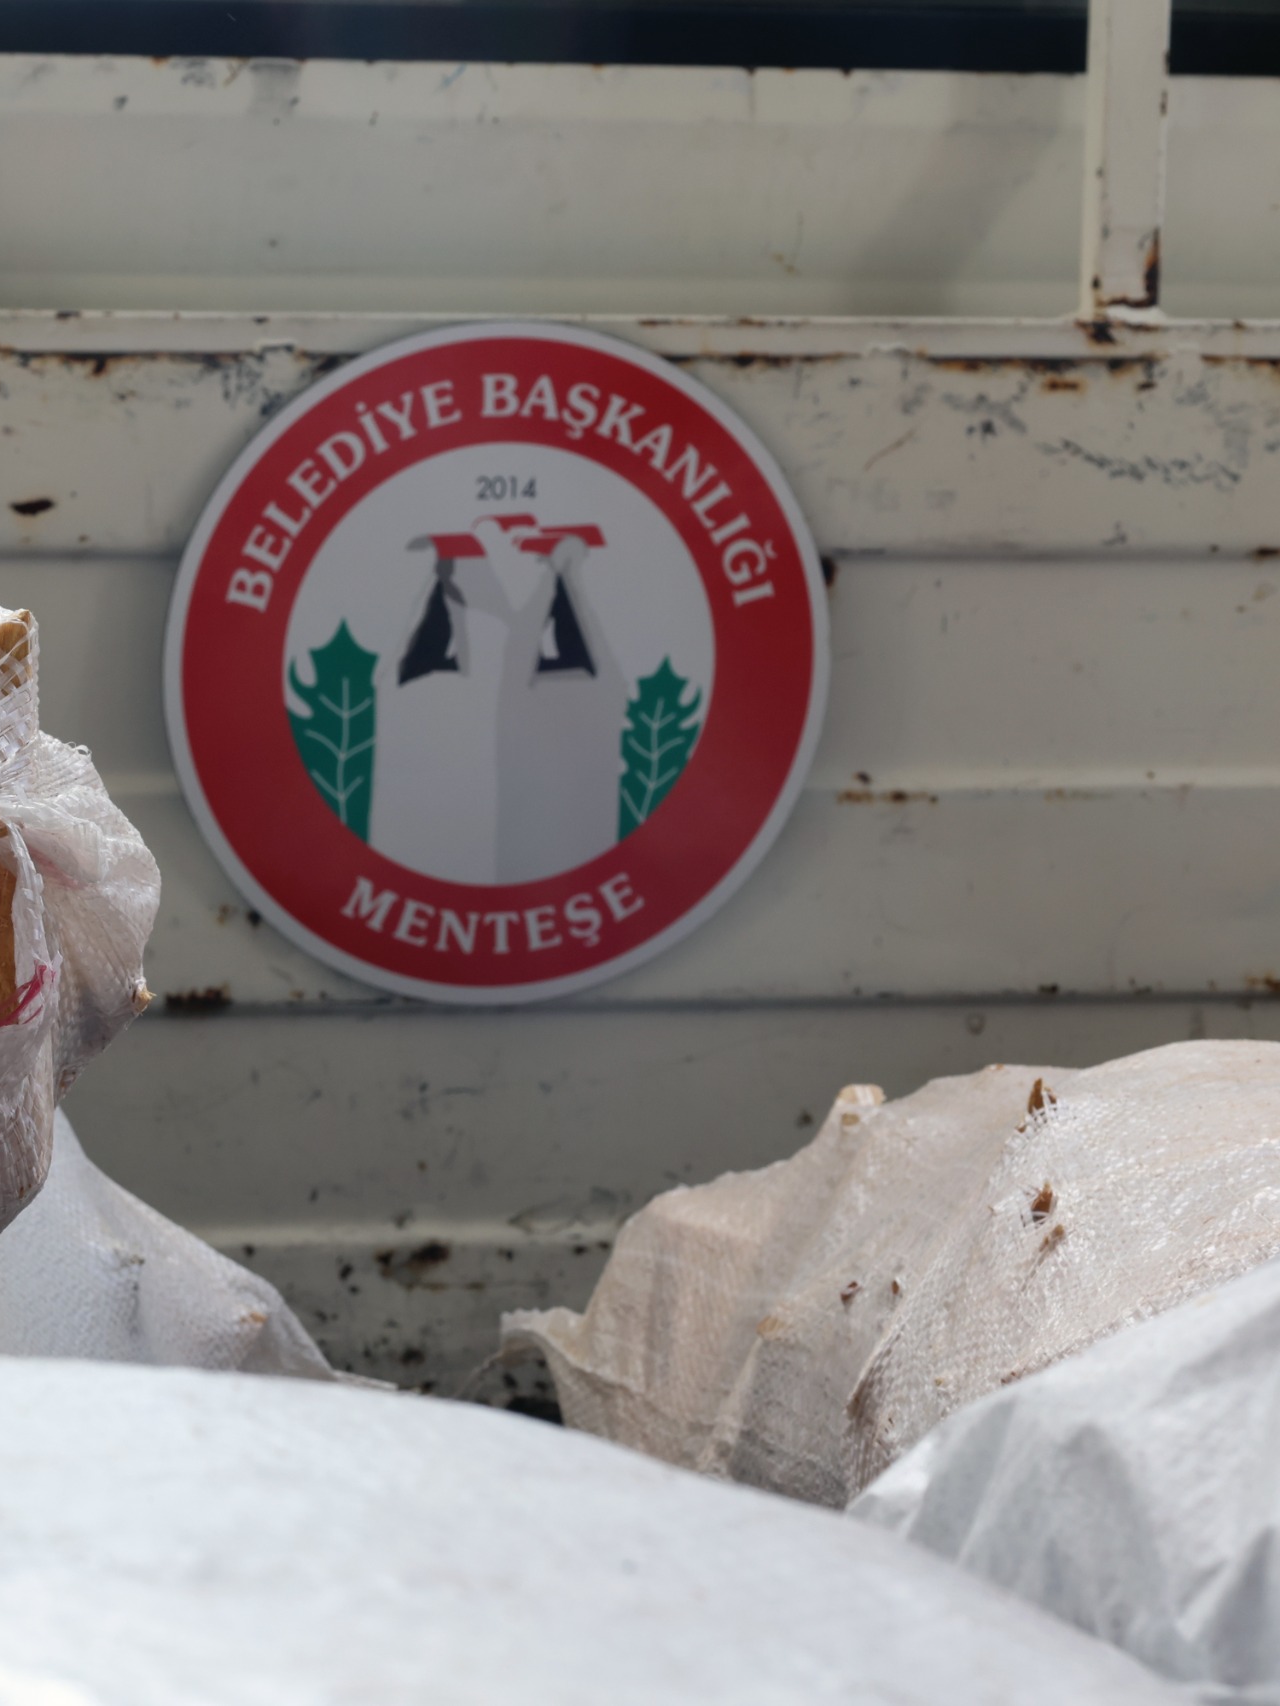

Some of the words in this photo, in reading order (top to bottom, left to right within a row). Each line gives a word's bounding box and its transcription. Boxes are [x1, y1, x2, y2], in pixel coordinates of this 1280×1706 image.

[227, 379, 462, 612] BELEDİYE
[480, 373, 775, 607] BAŞKANLIĞI
[476, 475, 537, 500] 2014
[341, 873, 645, 954] MENTEŞE
